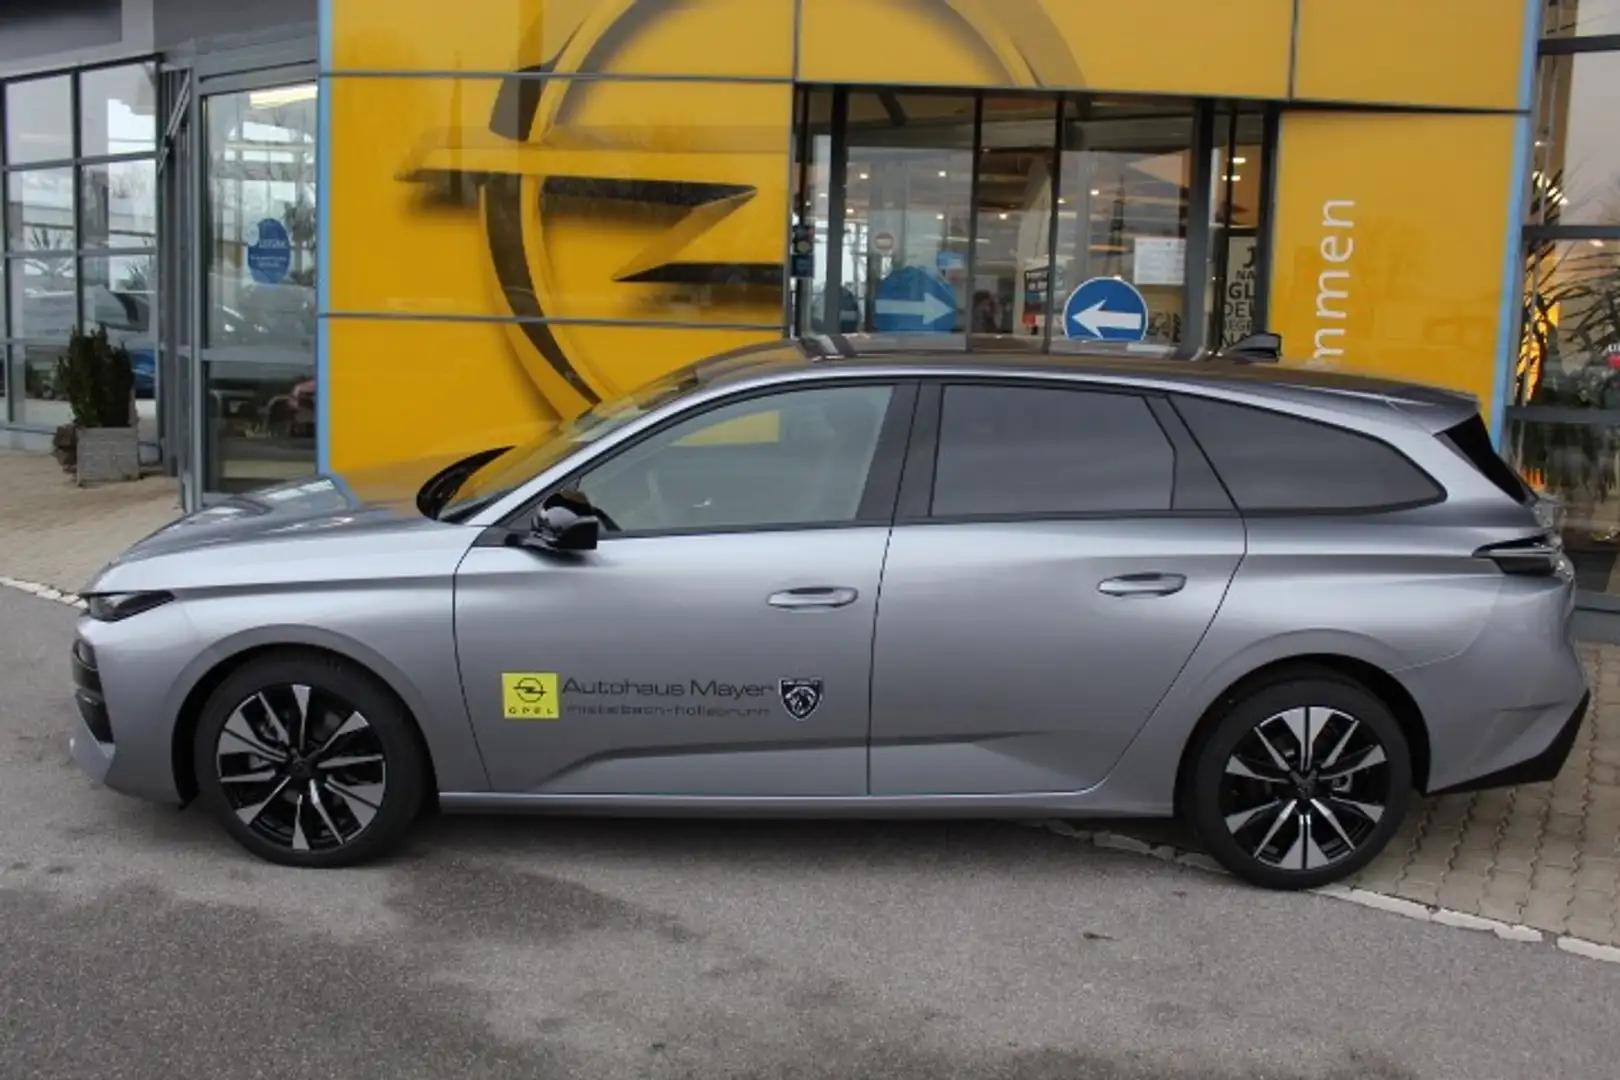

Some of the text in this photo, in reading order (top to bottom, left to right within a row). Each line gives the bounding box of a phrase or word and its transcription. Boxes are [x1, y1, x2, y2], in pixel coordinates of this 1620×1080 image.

[562, 678, 774, 700] Autohaus Mayer
[508, 706, 554, 715] OPEL
